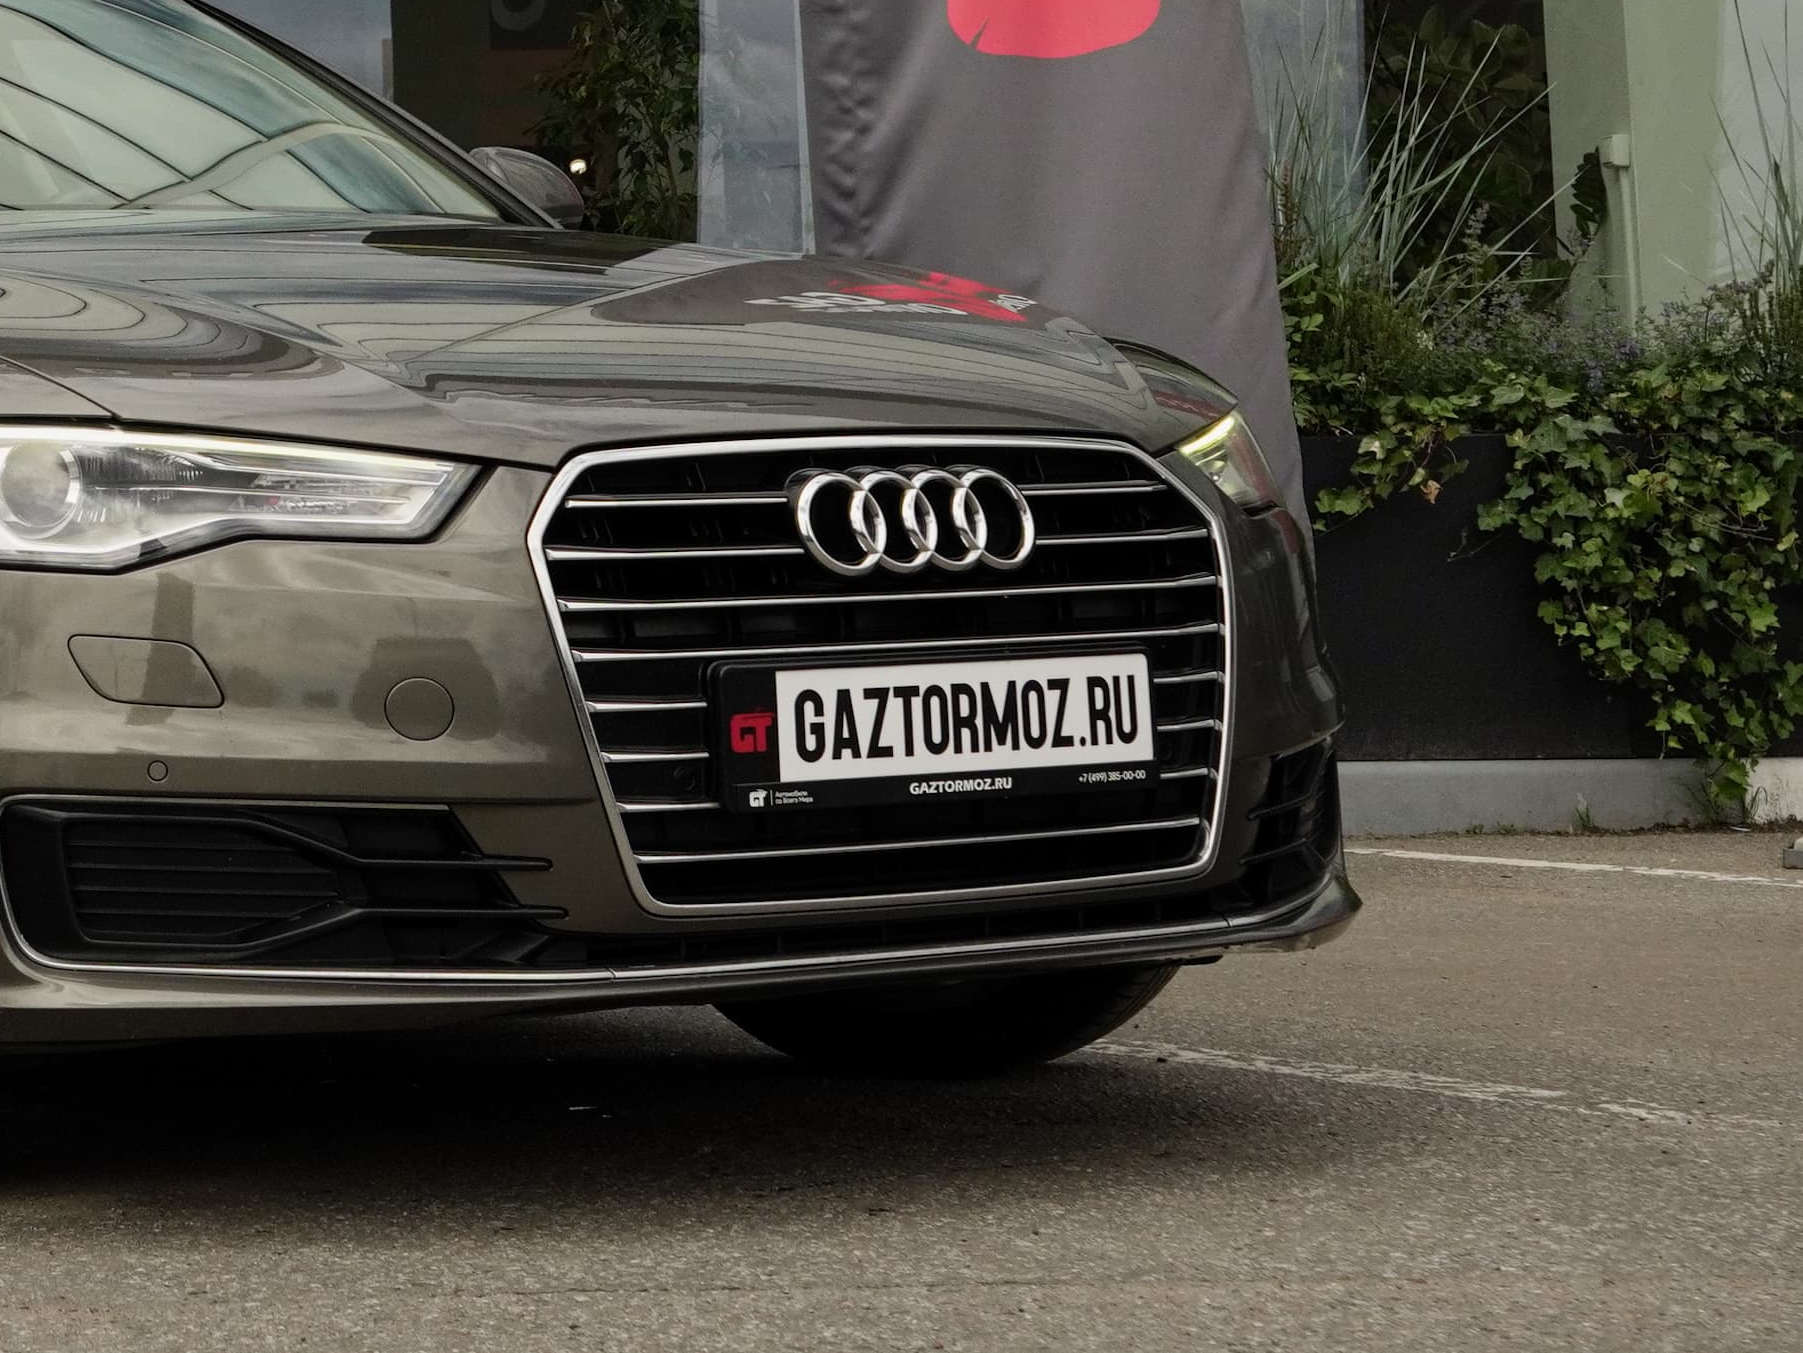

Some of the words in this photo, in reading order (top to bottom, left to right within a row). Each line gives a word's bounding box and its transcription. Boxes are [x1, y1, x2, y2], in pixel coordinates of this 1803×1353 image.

[729, 711, 773, 754] GT
[794, 674, 1138, 763] GAZTORMOZ.RU
[909, 777, 1013, 795] GAZTORMOZ.RU
